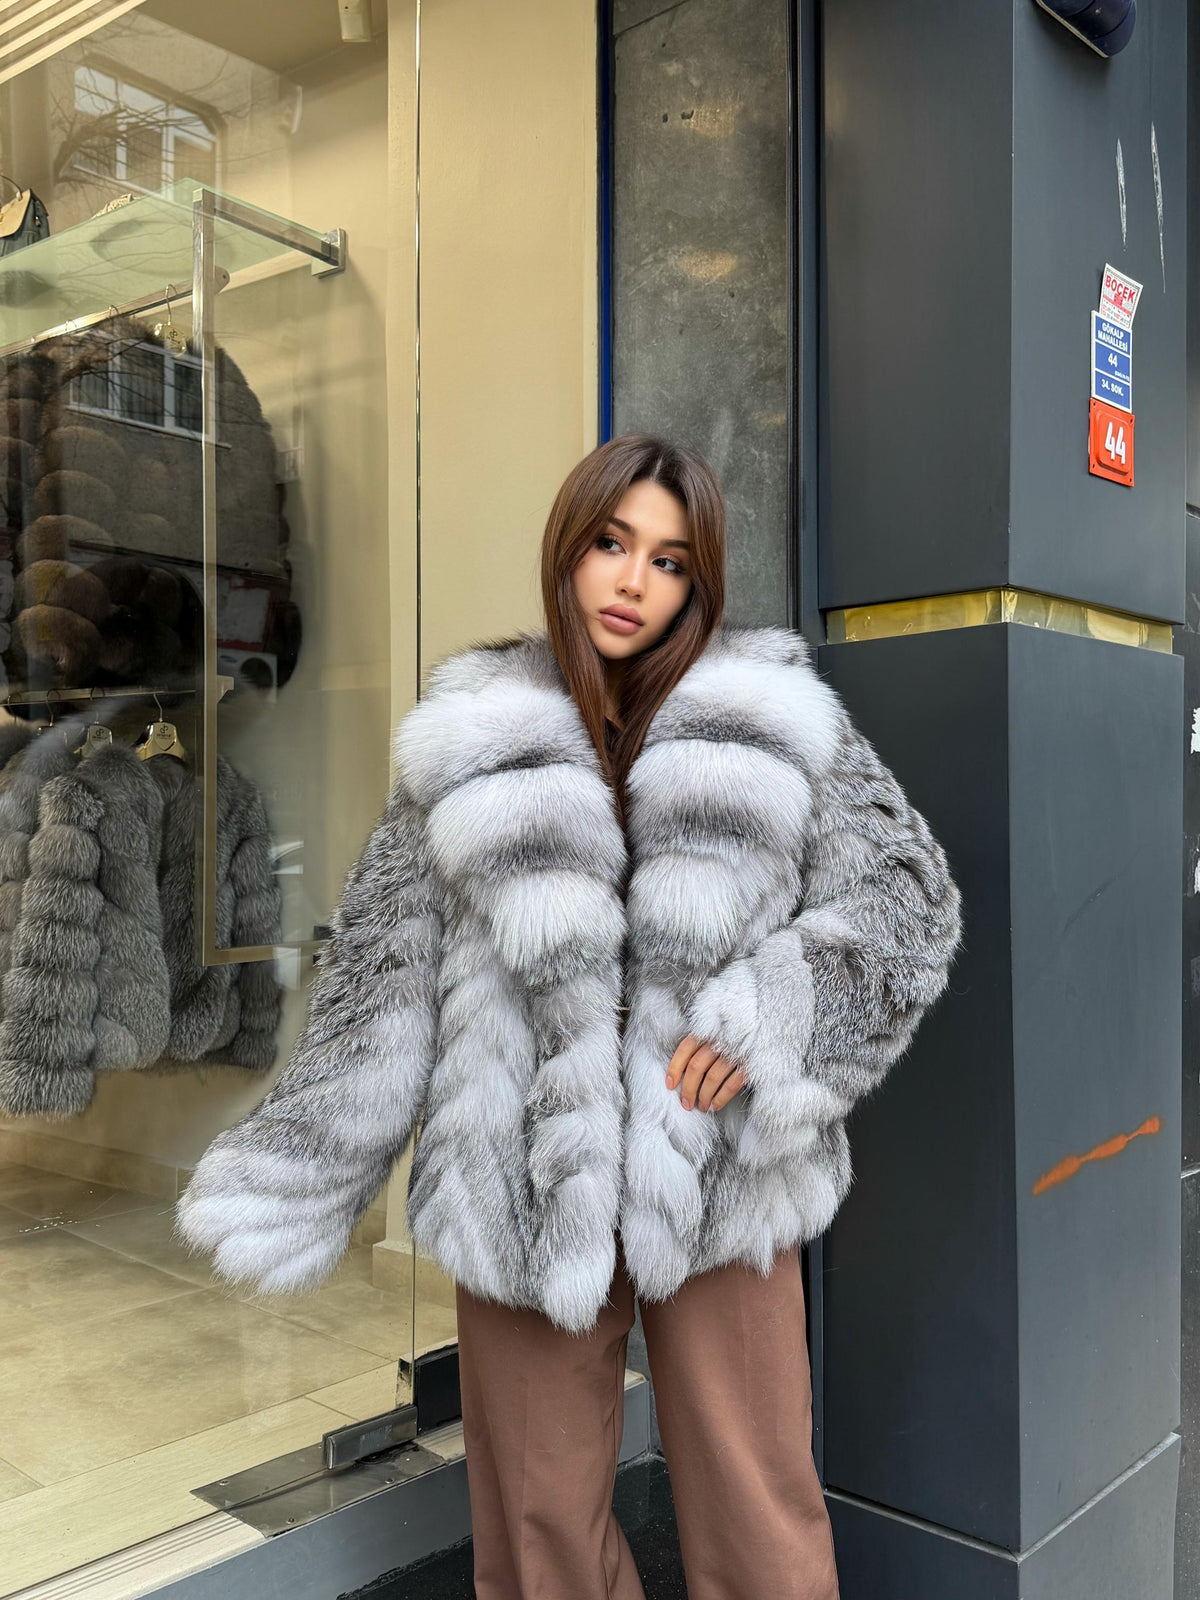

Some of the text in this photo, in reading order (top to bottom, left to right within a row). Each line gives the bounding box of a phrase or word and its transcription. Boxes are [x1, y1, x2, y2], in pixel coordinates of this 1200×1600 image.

[1101, 321, 1124, 340] GÖKALP
[1097, 330, 1128, 352] MAHALLESİ
[1108, 353, 1118, 367] 44
[1101, 379, 1124, 396] 34. SOK.
[1105, 421, 1126, 465] 44
